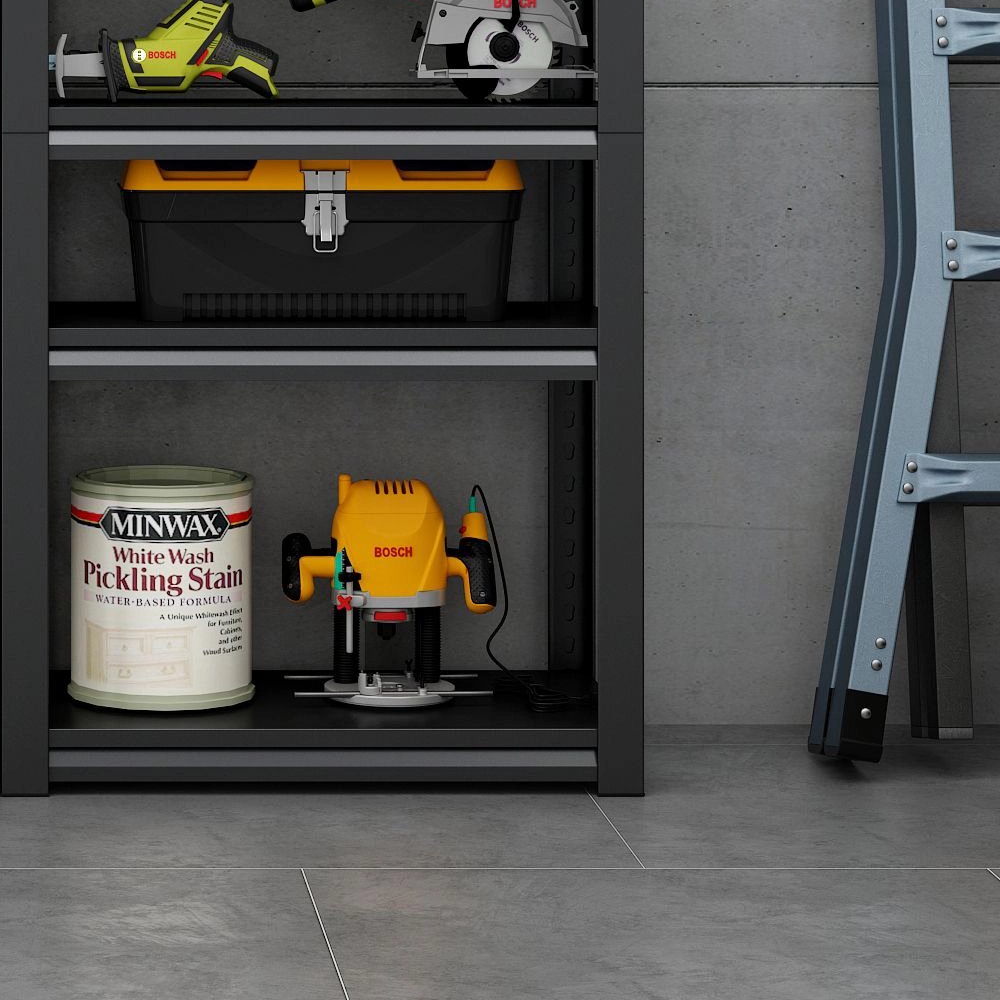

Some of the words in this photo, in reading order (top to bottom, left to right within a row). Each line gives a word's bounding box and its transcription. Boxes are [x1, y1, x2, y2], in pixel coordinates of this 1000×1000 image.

[517, 20, 540, 43] BOSCH
[148, 51, 176, 60] BOSCH
[111, 512, 220, 538] MINWAX
[112, 546, 165, 565] White
[168, 547, 214, 565] Wash
[374, 546, 413, 558] BOSCH
[83, 559, 183, 597] Pickling
[189, 564, 243, 591] Stain
[95, 593, 175, 607] WATER-BASED
[180, 595, 232, 607] FORMULA
[167, 613, 194, 621] Unique
[195, 610, 229, 619] Whitewash
[218, 637, 229, 645] and
[202, 647, 222, 656] Wood
